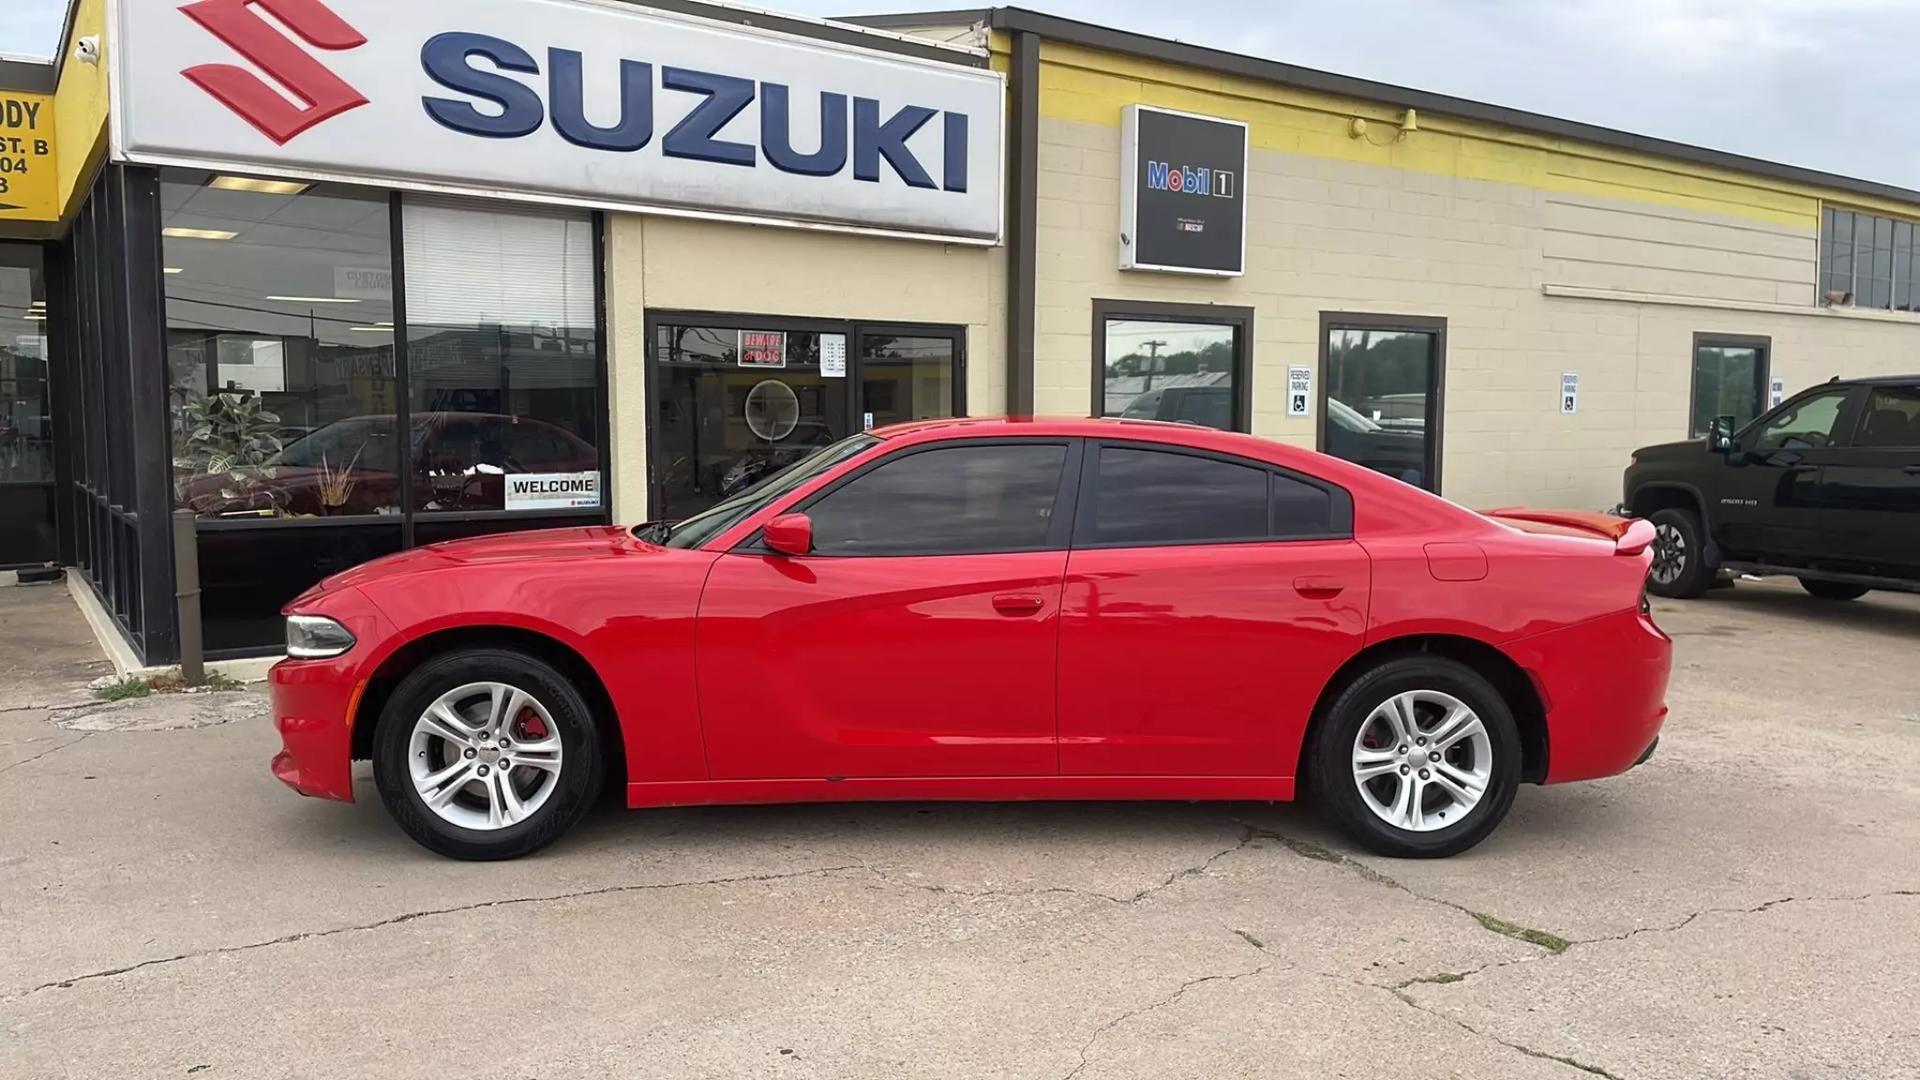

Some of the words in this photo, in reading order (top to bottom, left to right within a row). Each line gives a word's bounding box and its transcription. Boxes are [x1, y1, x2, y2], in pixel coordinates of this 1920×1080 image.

[0, 99, 41, 130] DY
[420, 31, 968, 193] SUZUKI
[34, 139, 49, 156] B
[1147, 160, 1210, 195] Mobil
[744, 333, 781, 347] BEWARE
[755, 350, 781, 362] DOG
[513, 479, 594, 494] WELCOME
